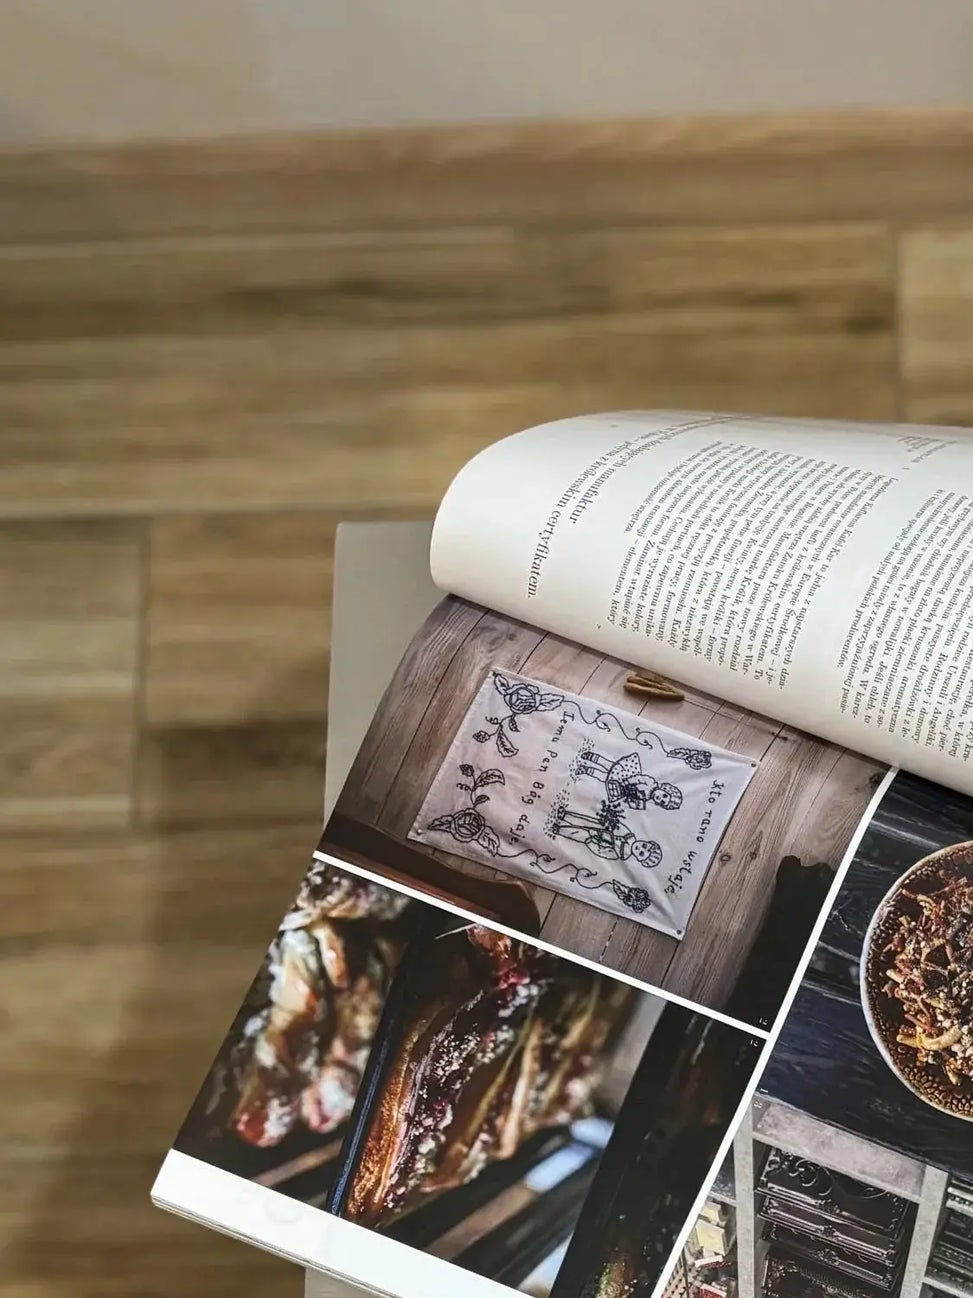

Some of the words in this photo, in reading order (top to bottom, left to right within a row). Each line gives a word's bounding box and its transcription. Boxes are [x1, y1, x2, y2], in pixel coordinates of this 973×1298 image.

[556, 459, 604, 510] królewskim
[567, 466, 616, 524] manufaktur
[525, 509, 562, 597] certyfikatem.
[666, 553, 676, 564] co
[773, 551, 796, 580] Zamku
[819, 563, 830, 572] to
[639, 557, 659, 601] wyraziste
[650, 564, 670, 607] zapewnia
[695, 571, 713, 595] która
[701, 570, 724, 611] powstają
[730, 576, 753, 607] Królik,
[778, 554, 809, 599] królewskim
[789, 572, 812, 606] Europie
[807, 572, 826, 597] jedna
[897, 583, 907, 592] to
[903, 578, 926, 605] bogaty
[924, 586, 933, 597] na
[747, 581, 762, 605] pisze
[859, 575, 880, 610] polskich
[913, 597, 929, 618] złoto
[605, 599, 620, 624] który
[712, 594, 731, 627] króliki
[723, 609, 739, 635] która
[735, 607, 751, 633] nowy
[747, 581, 779, 642] Królewskiego
[875, 599, 897, 639] własnego
[923, 597, 946, 623] dawką
[678, 606, 697, 651] niezwykłą
[692, 627, 703, 655] współ-
[756, 602, 781, 663] certyfikatem.
[769, 607, 797, 657] Środkowej
[782, 607, 807, 666] najstarszych
[836, 609, 863, 667] producentów.
[882, 615, 904, 656] nowalijki.
[901, 617, 918, 646] placki
[923, 623, 944, 662] puszyste
[702, 635, 718, 662] formy
[715, 635, 727, 665] propo-
[729, 634, 741, 672] rozdział
[842, 616, 875, 688] zaprzyjaźnionej
[862, 640, 879, 674] ogrodu.
[903, 625, 932, 671] kruszonki,
[952, 630, 970, 662] rodzice
[741, 652, 753, 674] War-
[753, 667, 763, 680] To
[777, 667, 789, 689] dzia-
[873, 660, 889, 684] Jeśli
[880, 646, 907, 707] ziemniaczane
[922, 652, 949, 697] Rodzinny
[864, 685, 879, 710] chleb,
[938, 664, 959, 700] Urszuli
[839, 686, 849, 713] pasie-
[851, 690, 865, 717] karcz-
[888, 675, 908, 733] aromatyczna
[863, 713, 871, 723] to
[910, 707, 929, 744] domowy
[923, 707, 943, 746] Angeliki,
[943, 708, 955, 732] choć
[938, 731, 949, 751] pier-
[948, 731, 964, 759] której
[963, 743, 973, 761] kra-
[538, 748, 557, 775] Pan
[521, 781, 543, 805] Bóg
[705, 778, 725, 805] Kto
[508, 813, 530, 846] daje.
[694, 808, 714, 843] rano
[663, 850, 698, 895] wstaje,
